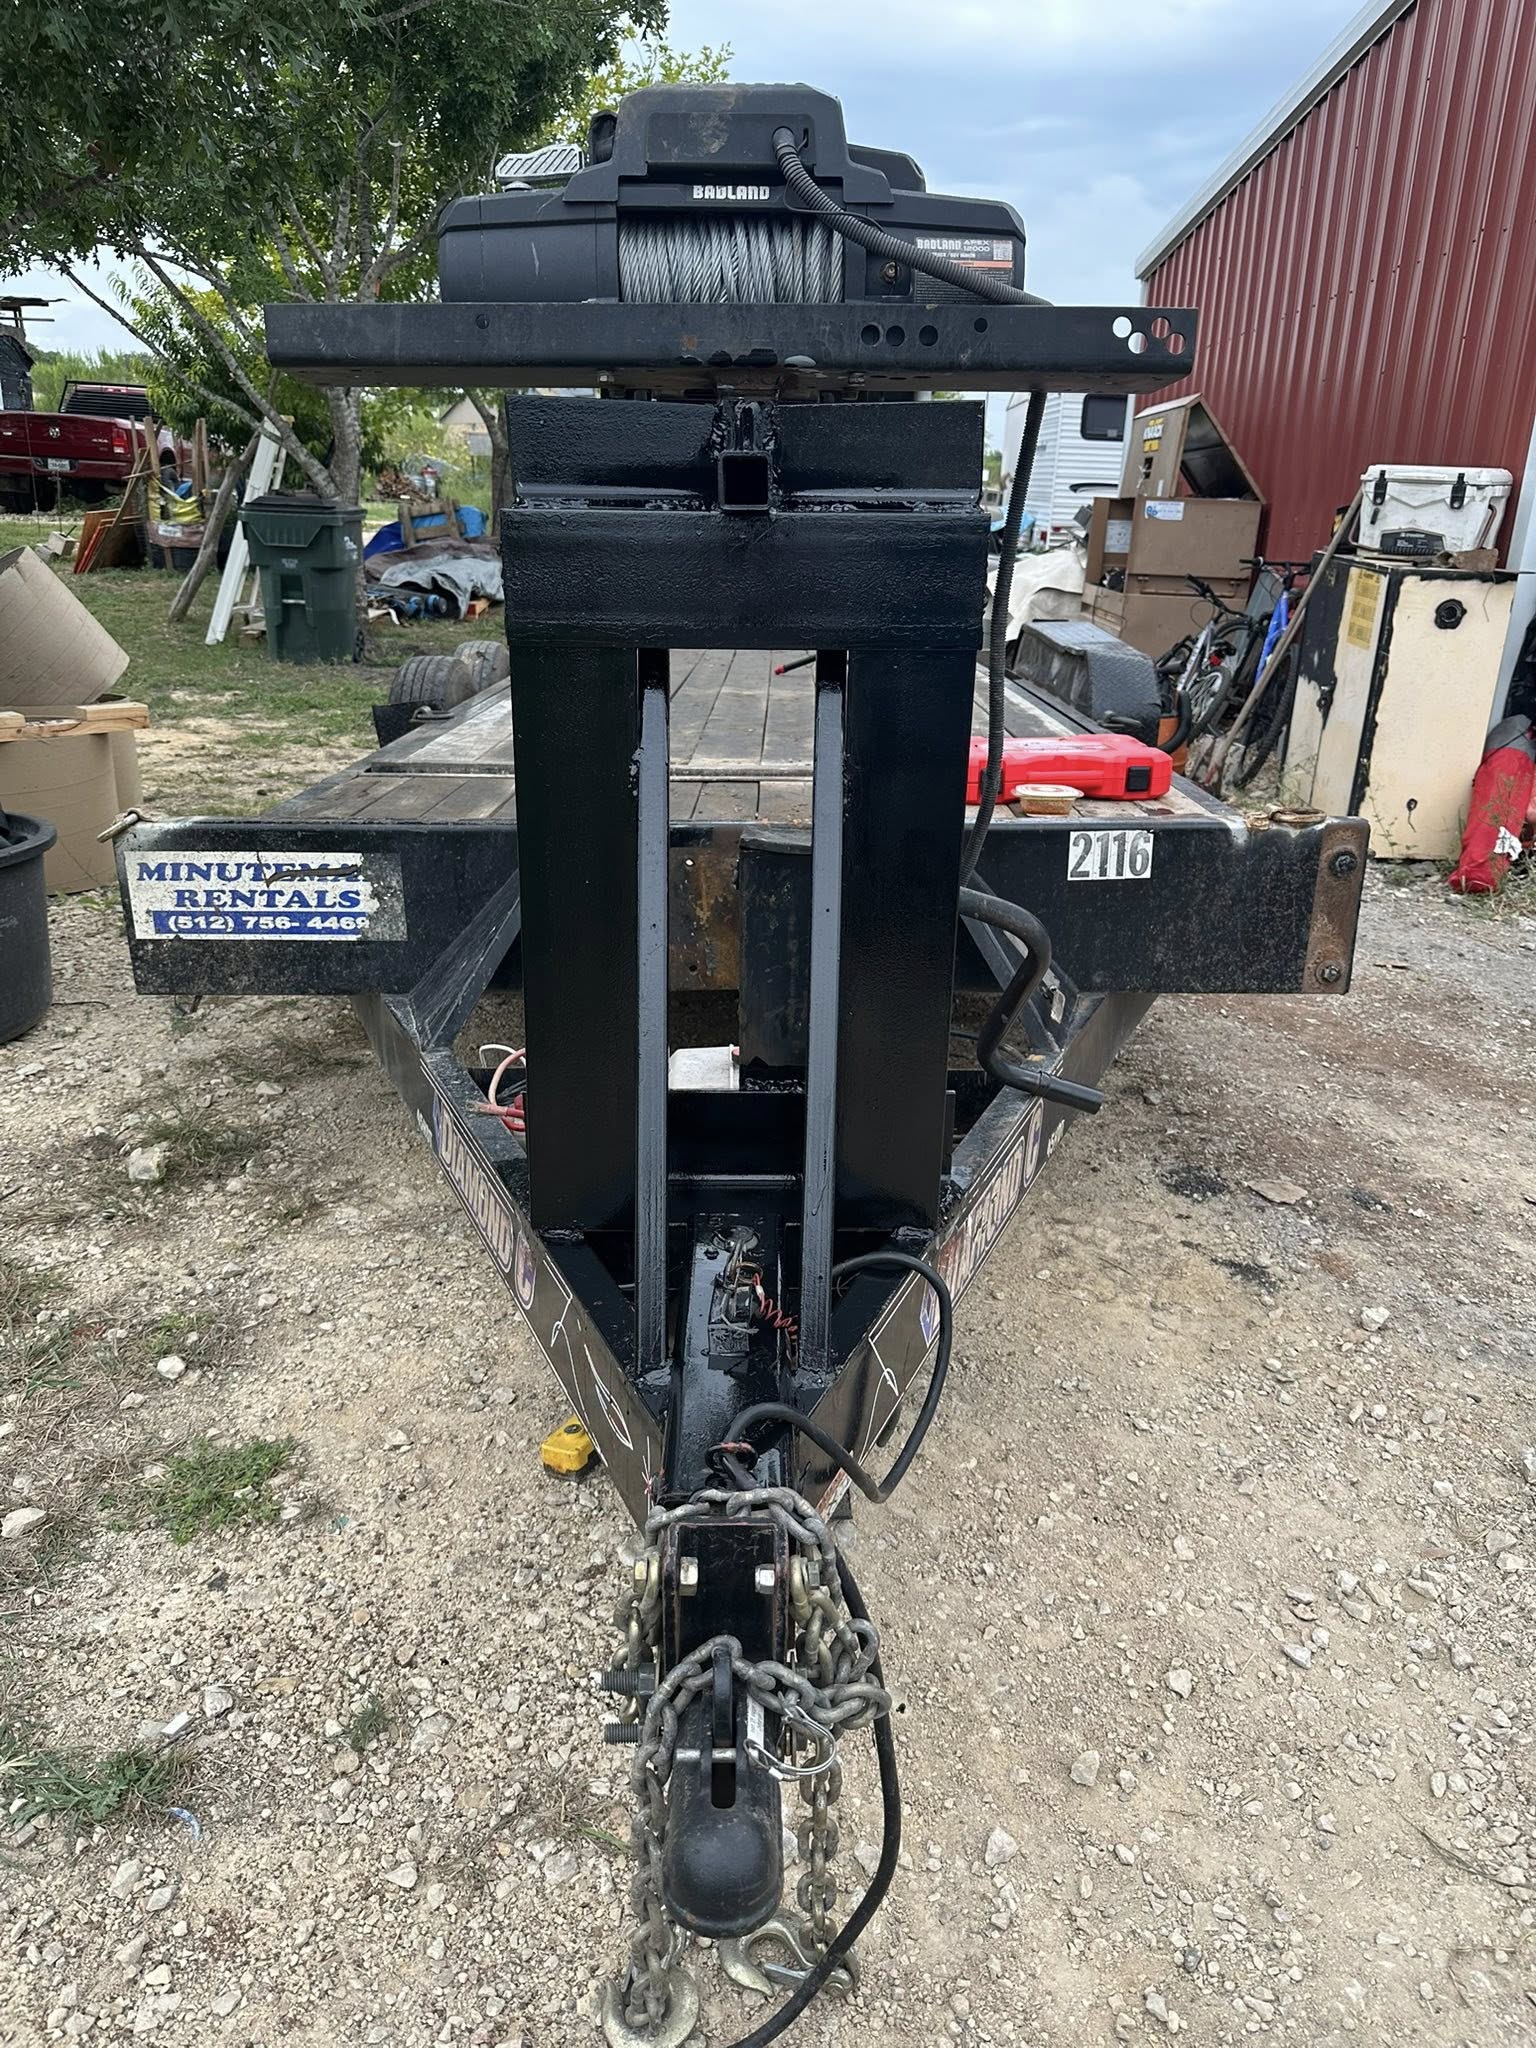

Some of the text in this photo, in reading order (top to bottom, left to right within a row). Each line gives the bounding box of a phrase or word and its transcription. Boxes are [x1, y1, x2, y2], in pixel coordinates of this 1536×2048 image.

[692, 184, 770, 201] BADLAND
[916, 238, 962, 251] BADLAND
[1069, 831, 1151, 878] 2116
[174, 888, 361, 909] RENTALS
[168, 914, 234, 933] (512)
[307, 915, 370, 930] 4469
